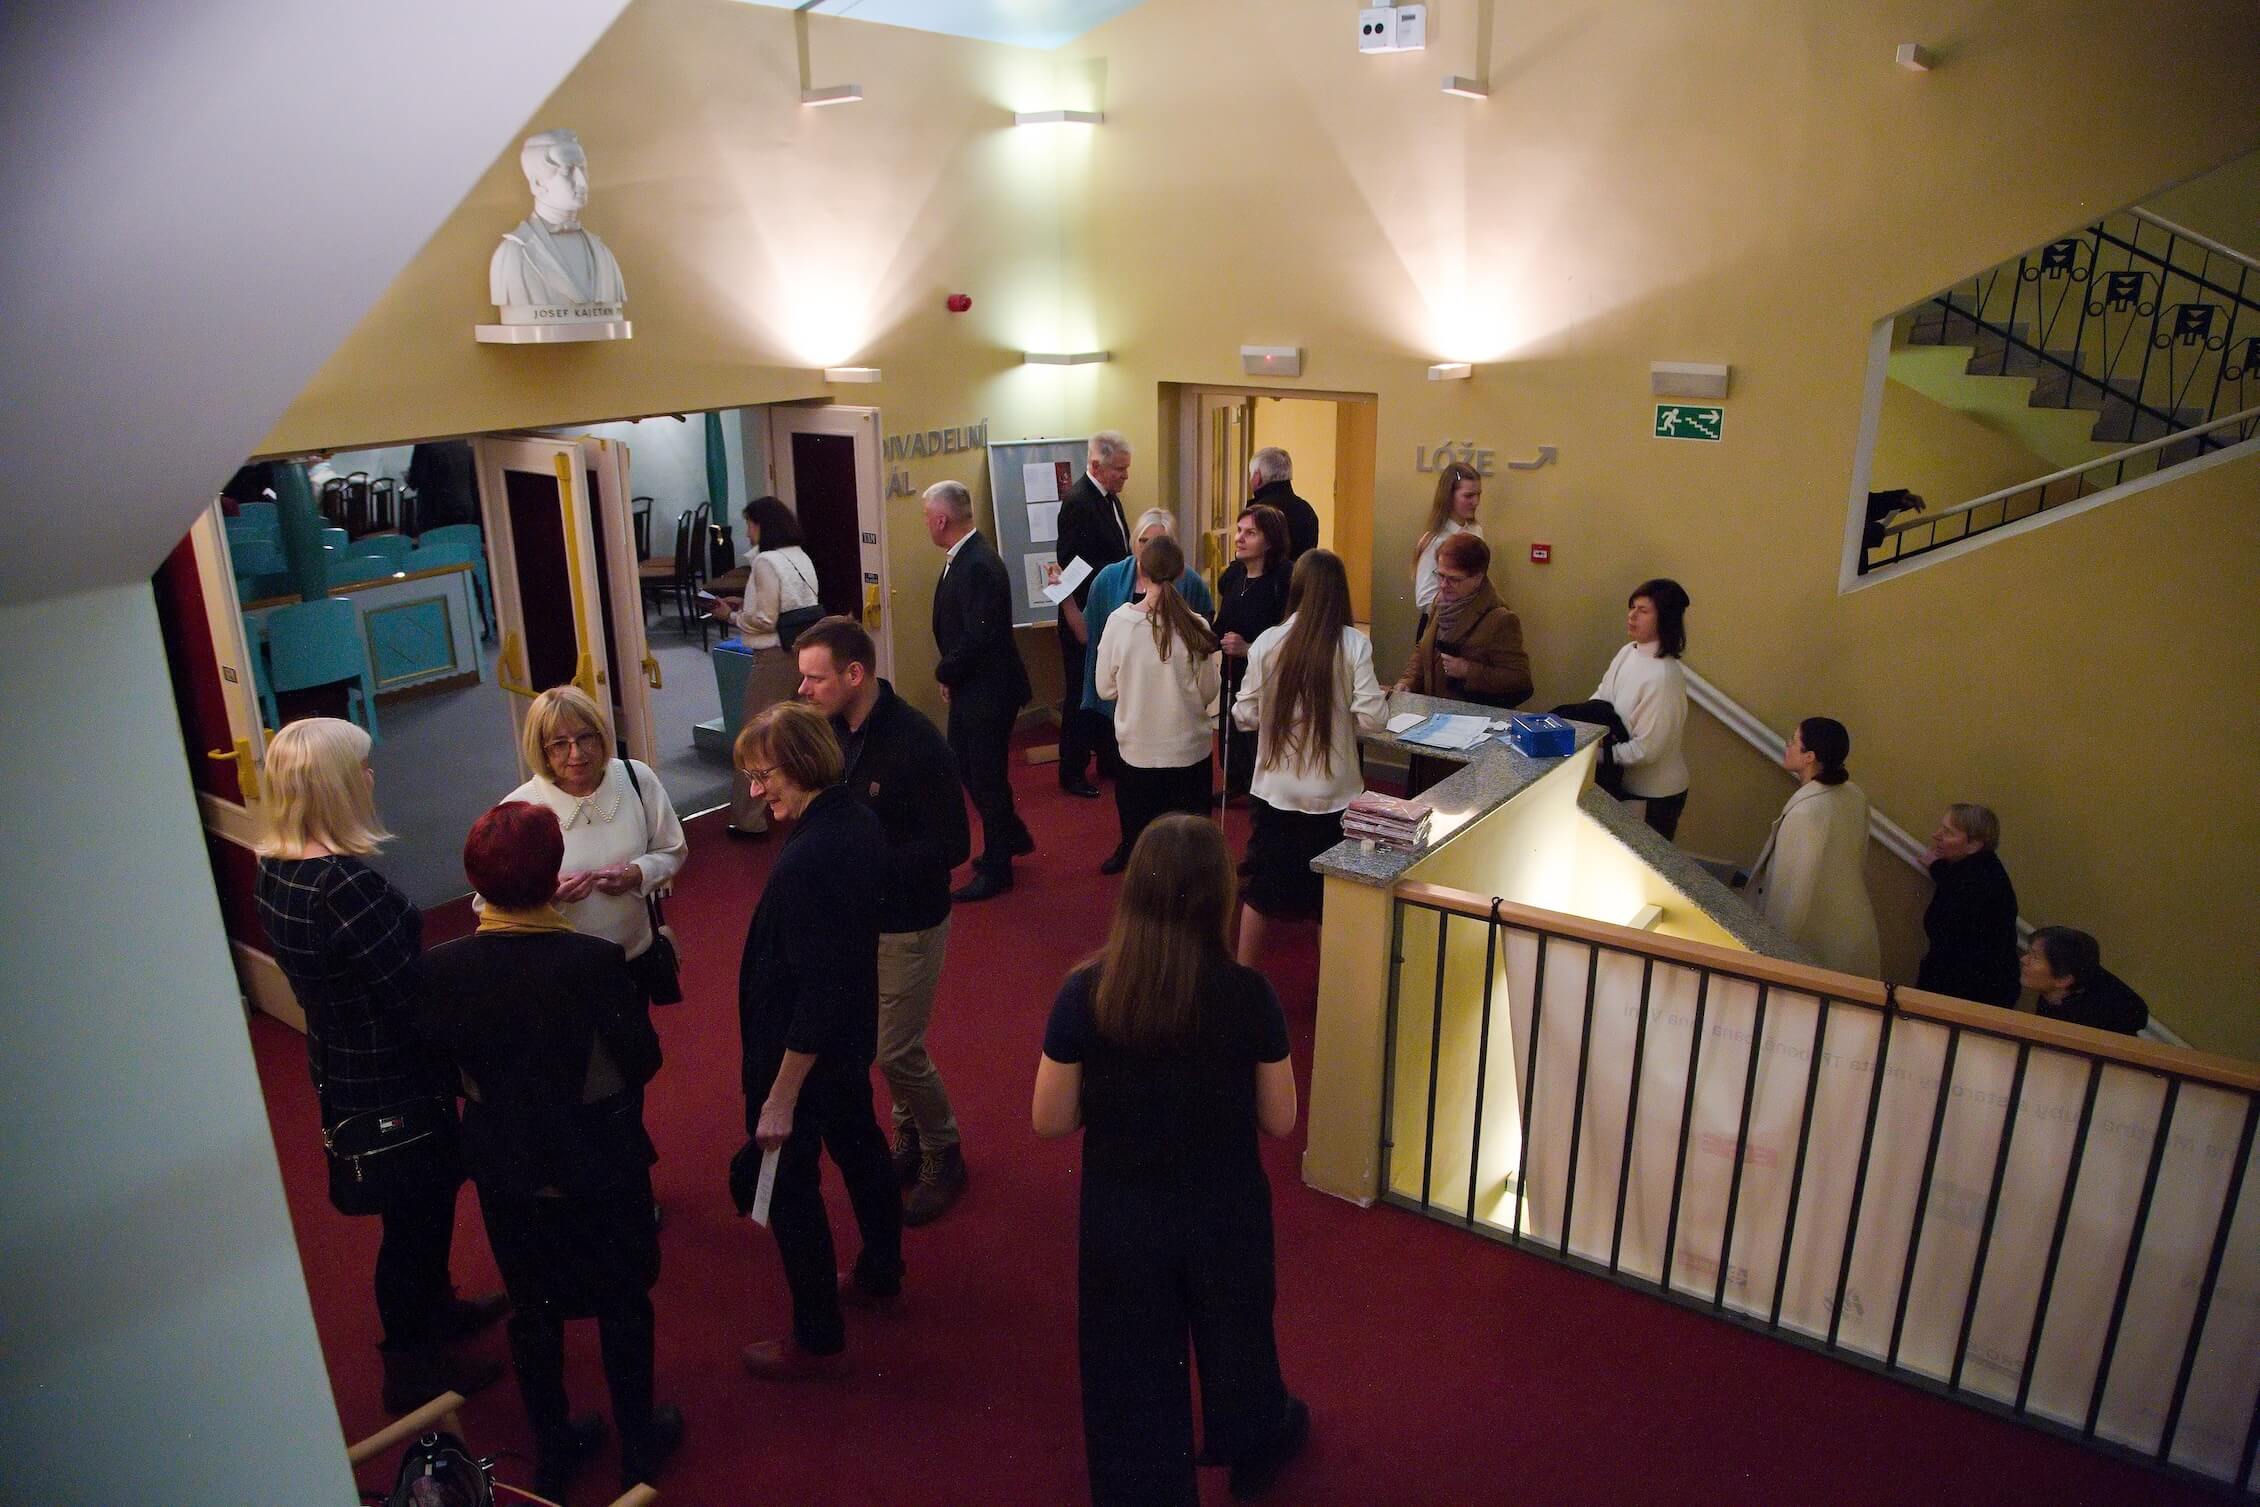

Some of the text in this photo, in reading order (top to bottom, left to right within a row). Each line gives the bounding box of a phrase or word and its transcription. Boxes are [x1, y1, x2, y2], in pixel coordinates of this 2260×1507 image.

[534, 309, 568, 318] JOSEF
[1415, 440, 1496, 477] LÓŽE
[885, 464, 917, 500] ÁL
